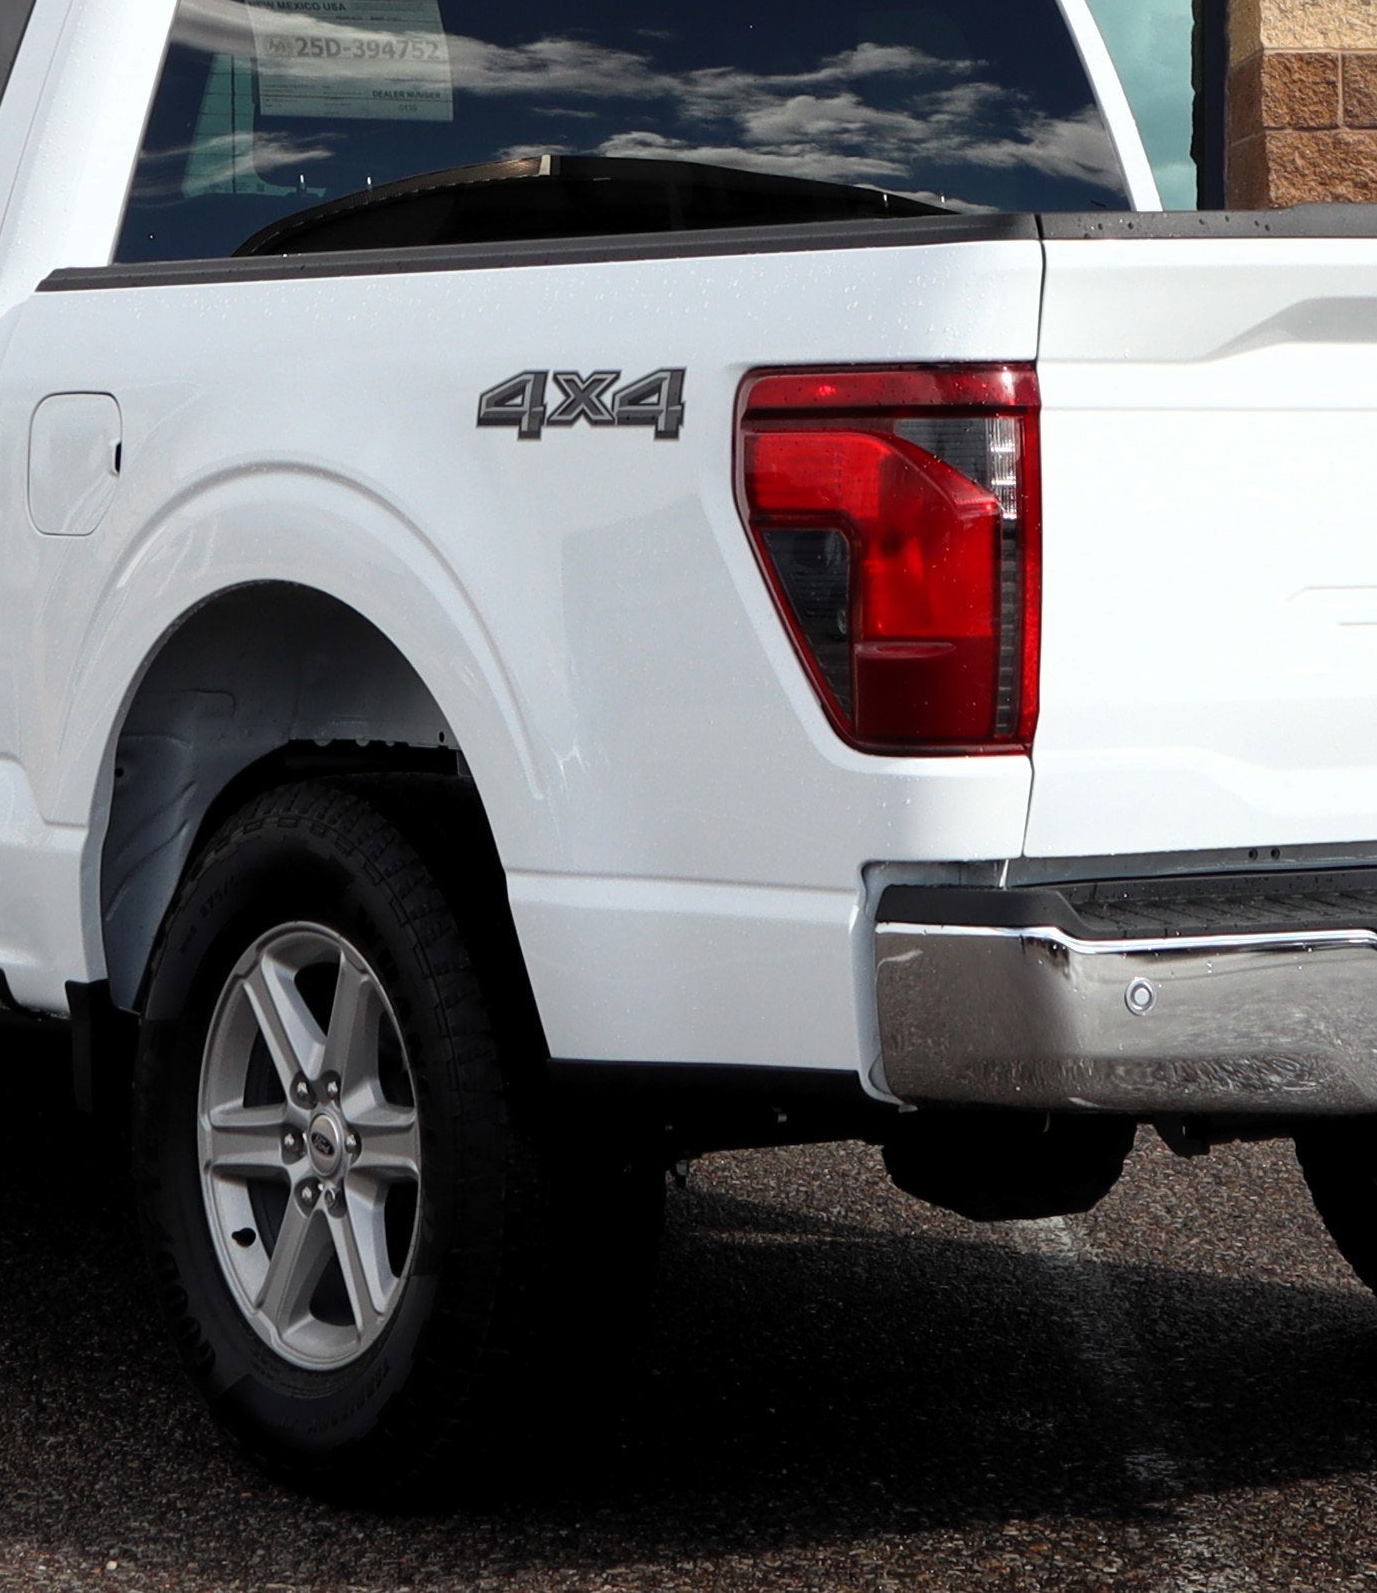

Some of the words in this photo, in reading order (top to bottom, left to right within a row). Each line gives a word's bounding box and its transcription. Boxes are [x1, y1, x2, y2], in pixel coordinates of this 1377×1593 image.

[277, 1, 321, 11] MEXICO
[322, 2, 347, 12] USA
[295, 37, 441, 60] 25D-394752
[372, 90, 405, 98] DEALER
[406, 91, 442, 99] NUMBER
